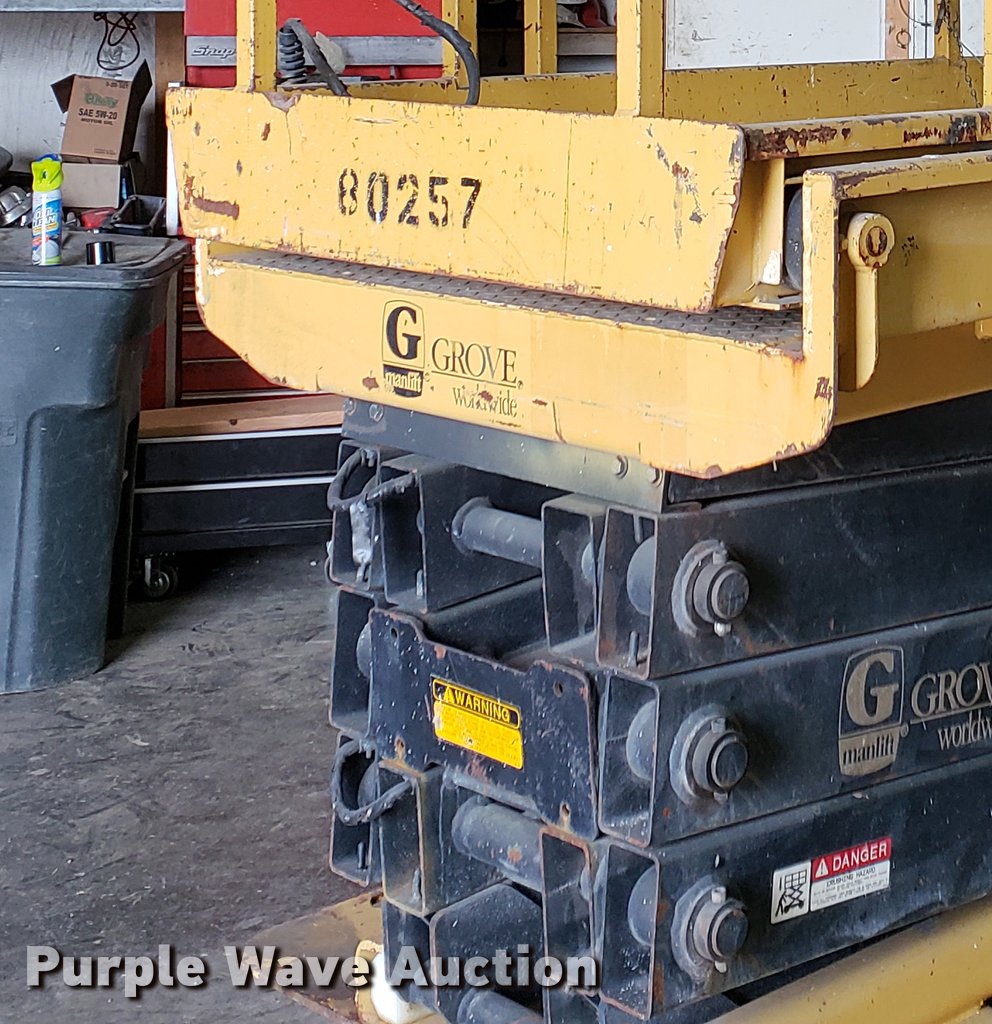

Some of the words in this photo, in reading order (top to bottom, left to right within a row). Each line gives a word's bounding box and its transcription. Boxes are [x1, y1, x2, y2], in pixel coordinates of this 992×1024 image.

[78, 107, 94, 118] SAE
[95, 110, 118, 120] 5W-20
[338, 168, 482, 229] 80257
[386, 306, 421, 360] G
[431, 337, 517, 384] GROVE
[384, 370, 422, 393] manlift
[454, 689, 510, 723] WARNING
[846, 651, 899, 726] G
[832, 839, 887, 872] DANGER
